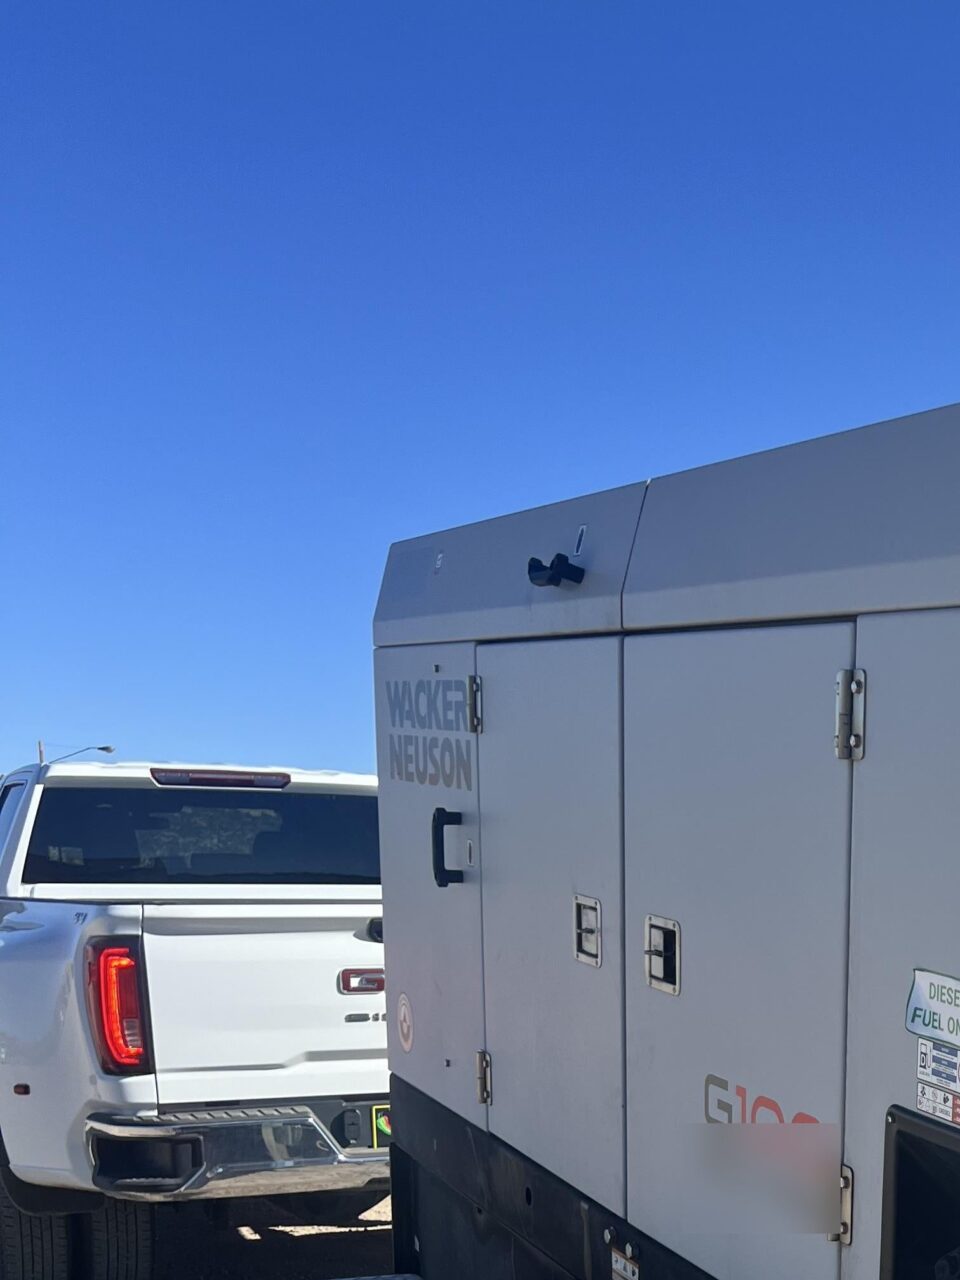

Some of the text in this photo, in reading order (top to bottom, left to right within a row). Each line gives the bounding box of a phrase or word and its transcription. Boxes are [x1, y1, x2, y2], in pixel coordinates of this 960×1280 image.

[385, 679, 468, 732] WACKER
[389, 734, 472, 791] NEUSON
[911, 1006, 944, 1031] FUEL
